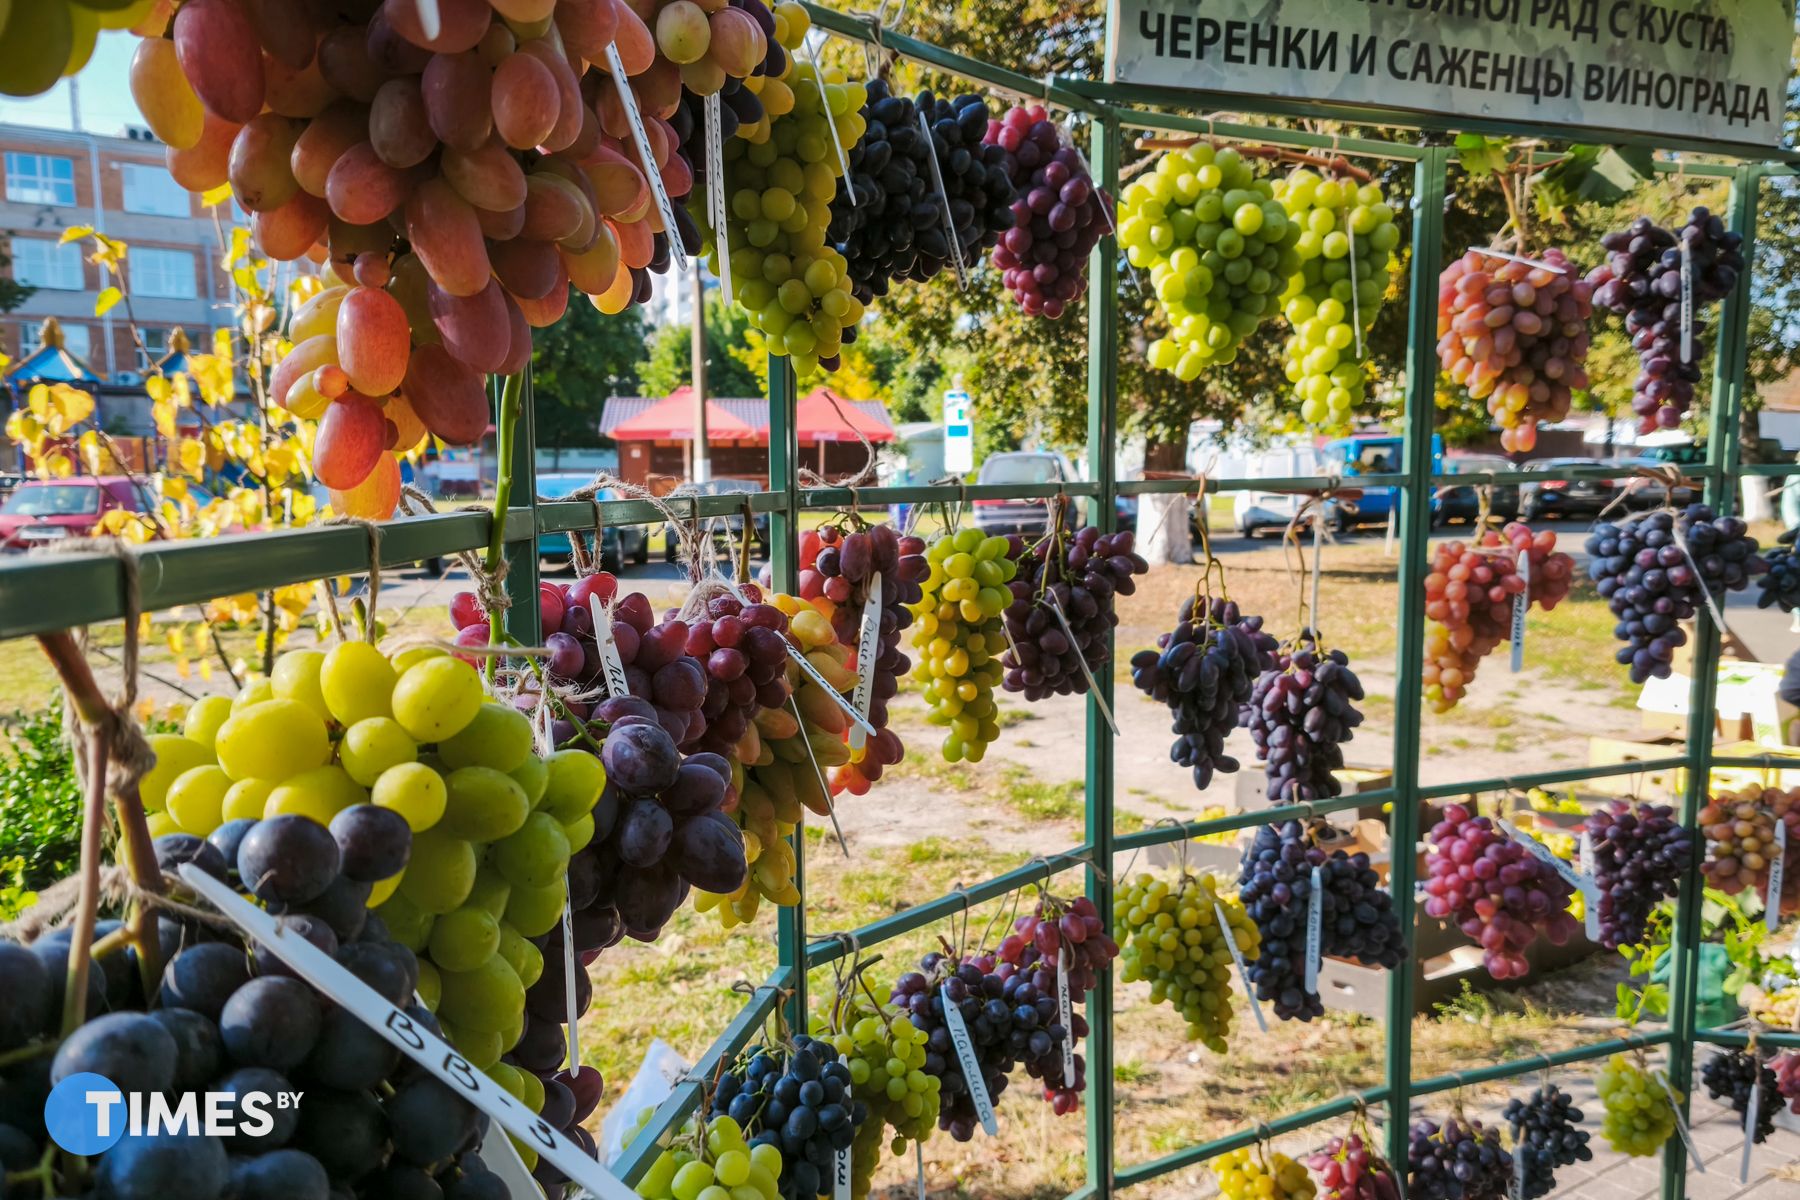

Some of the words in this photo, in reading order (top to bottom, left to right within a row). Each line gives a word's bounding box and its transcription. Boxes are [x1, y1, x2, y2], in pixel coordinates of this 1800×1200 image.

[1139, 10, 1338, 72] ЧЕРЕНКИ
[1349, 33, 1378, 77] И
[1386, 39, 1573, 104] САЖЕНЦЫ
[1583, 63, 1771, 128] ВИНОГРАДА
[1405, 0, 1599, 44] НОГРАД
[1608, 1, 1630, 39] С
[1637, 4, 1729, 55] КУСТА
[854, 615, 880, 713] Байкону
